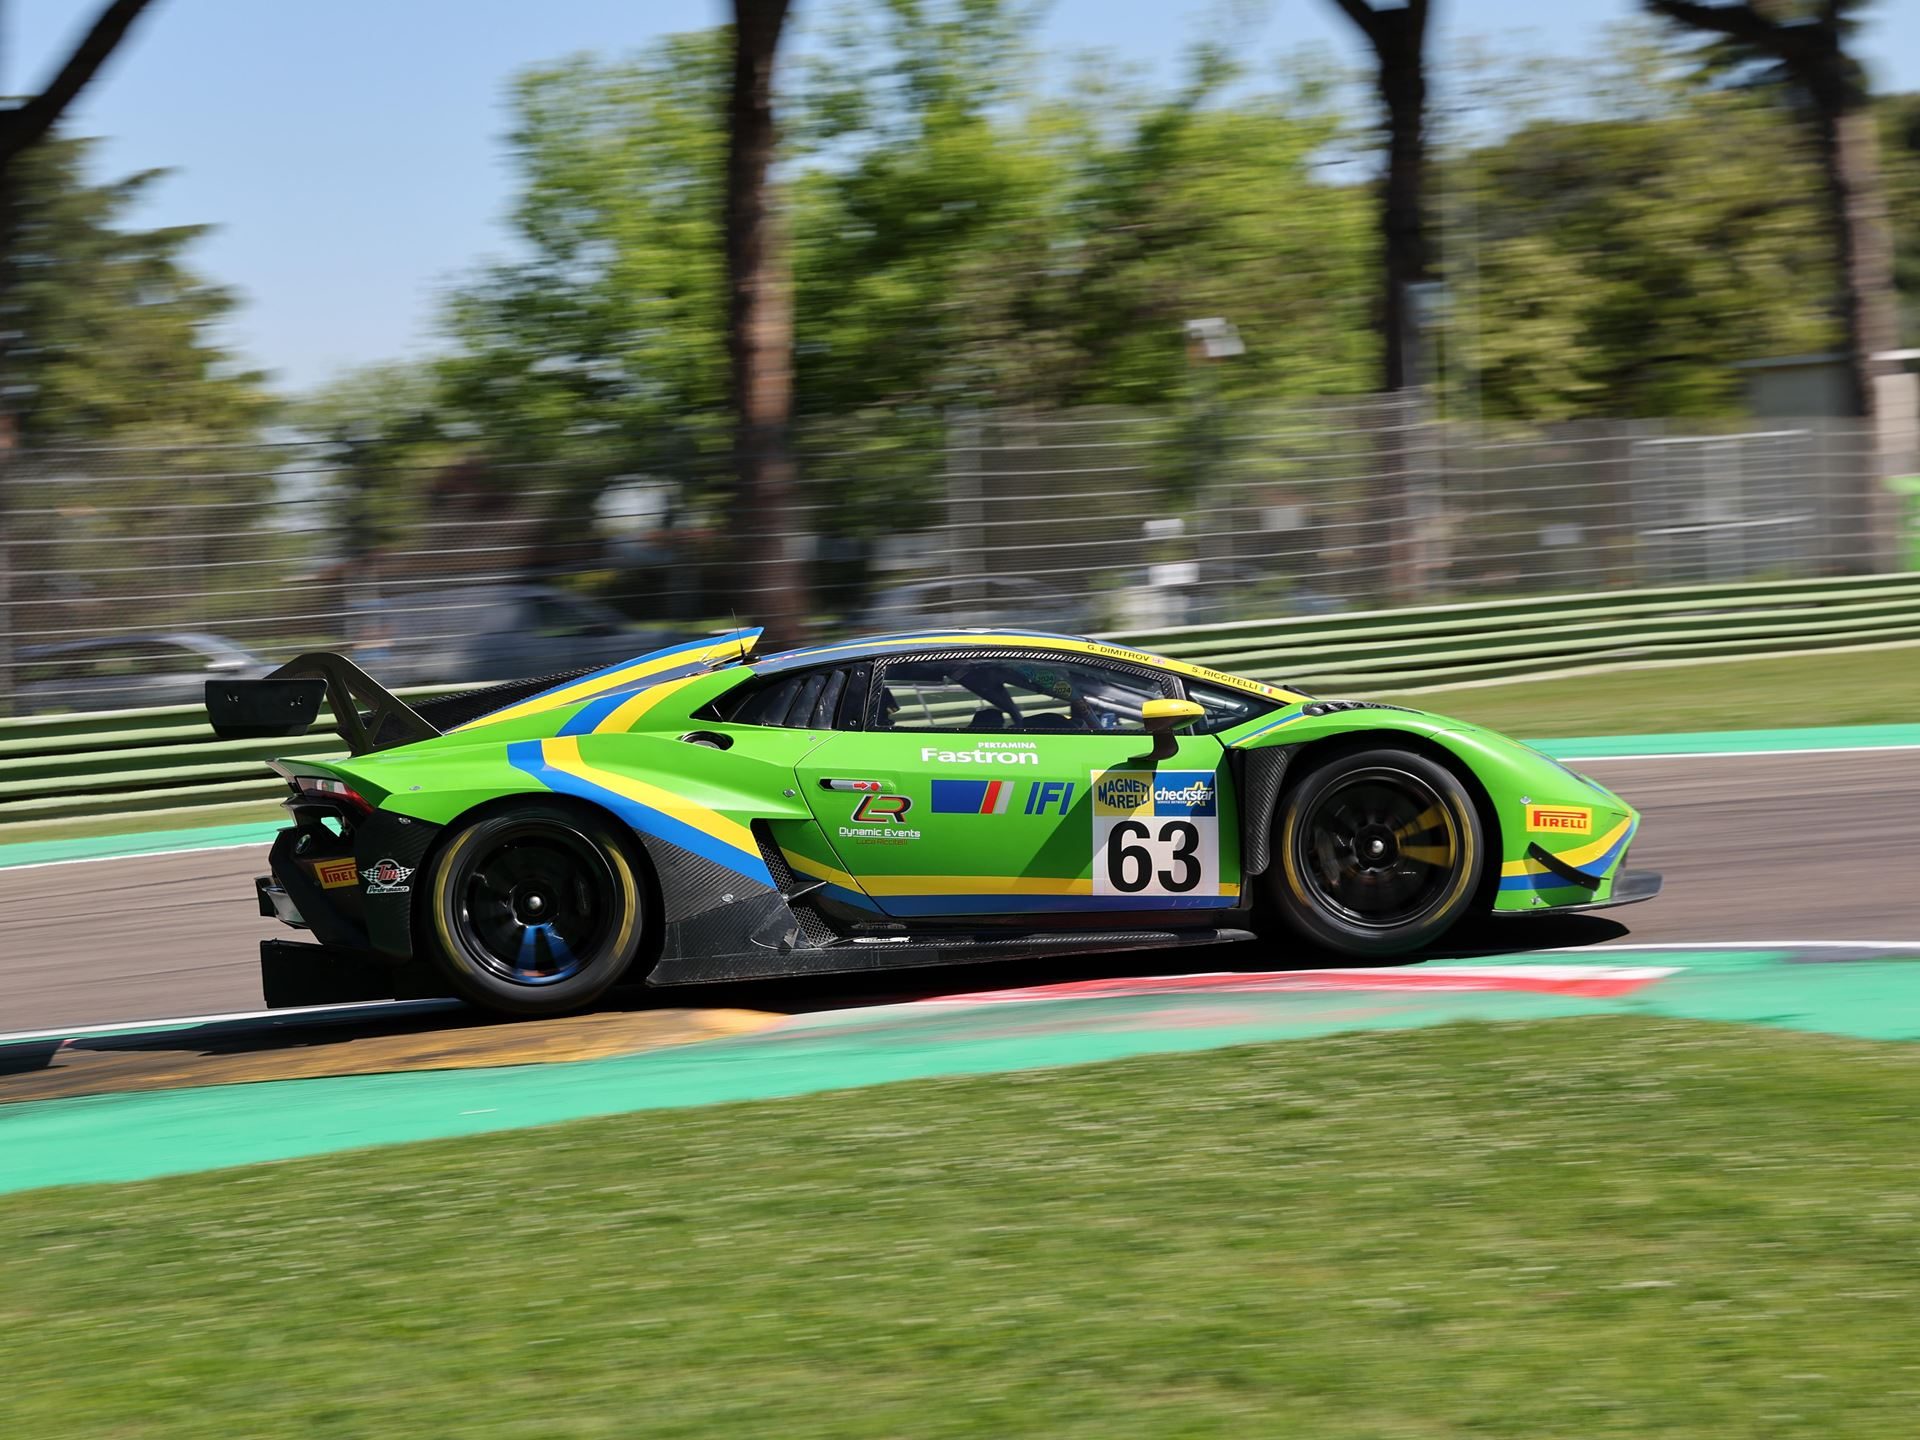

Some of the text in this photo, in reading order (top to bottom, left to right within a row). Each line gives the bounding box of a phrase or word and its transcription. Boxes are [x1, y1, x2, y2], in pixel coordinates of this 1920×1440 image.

[1087, 644, 1150, 662] G. DIMITROV
[1192, 666, 1258, 690] S. RICCITELLI
[921, 748, 1039, 765] Fastron
[1098, 778, 1150, 798] MAGNETI
[1154, 787, 1214, 801] checkstar
[1024, 781, 1075, 815] IFI
[1098, 790, 1150, 809] MARELLI
[1533, 810, 1588, 829] PIRELLI
[839, 827, 921, 838] Dynamic Events
[1107, 820, 1202, 893] 63
